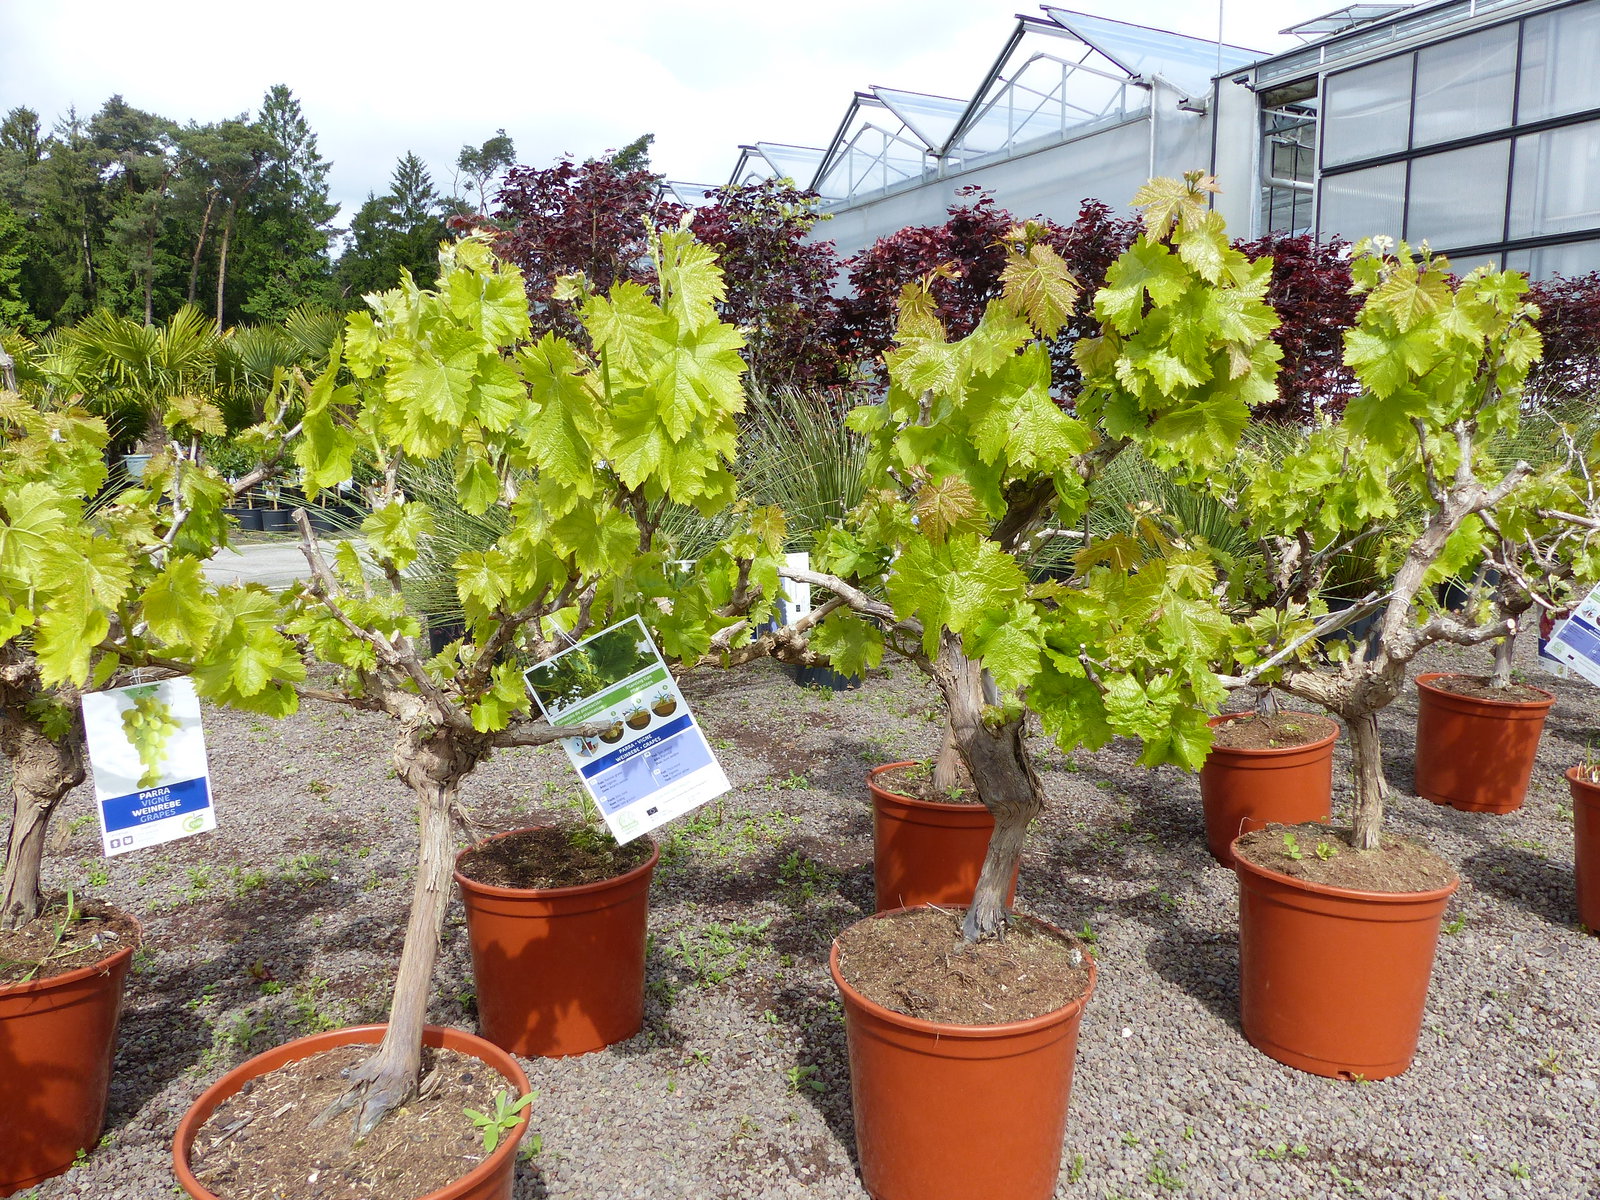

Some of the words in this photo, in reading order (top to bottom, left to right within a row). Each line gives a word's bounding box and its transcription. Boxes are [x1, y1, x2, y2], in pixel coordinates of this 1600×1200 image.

[615, 747, 640, 762] WEINREBE
[642, 736, 662, 749] GRAPES
[618, 742, 635, 754] PARRA
[637, 733, 653, 744] VIGNE
[139, 787, 171, 800] PARRA
[141, 794, 170, 807] VIGNE
[131, 799, 182, 817] WEINREBE
[140, 809, 176, 823] GRAPES
